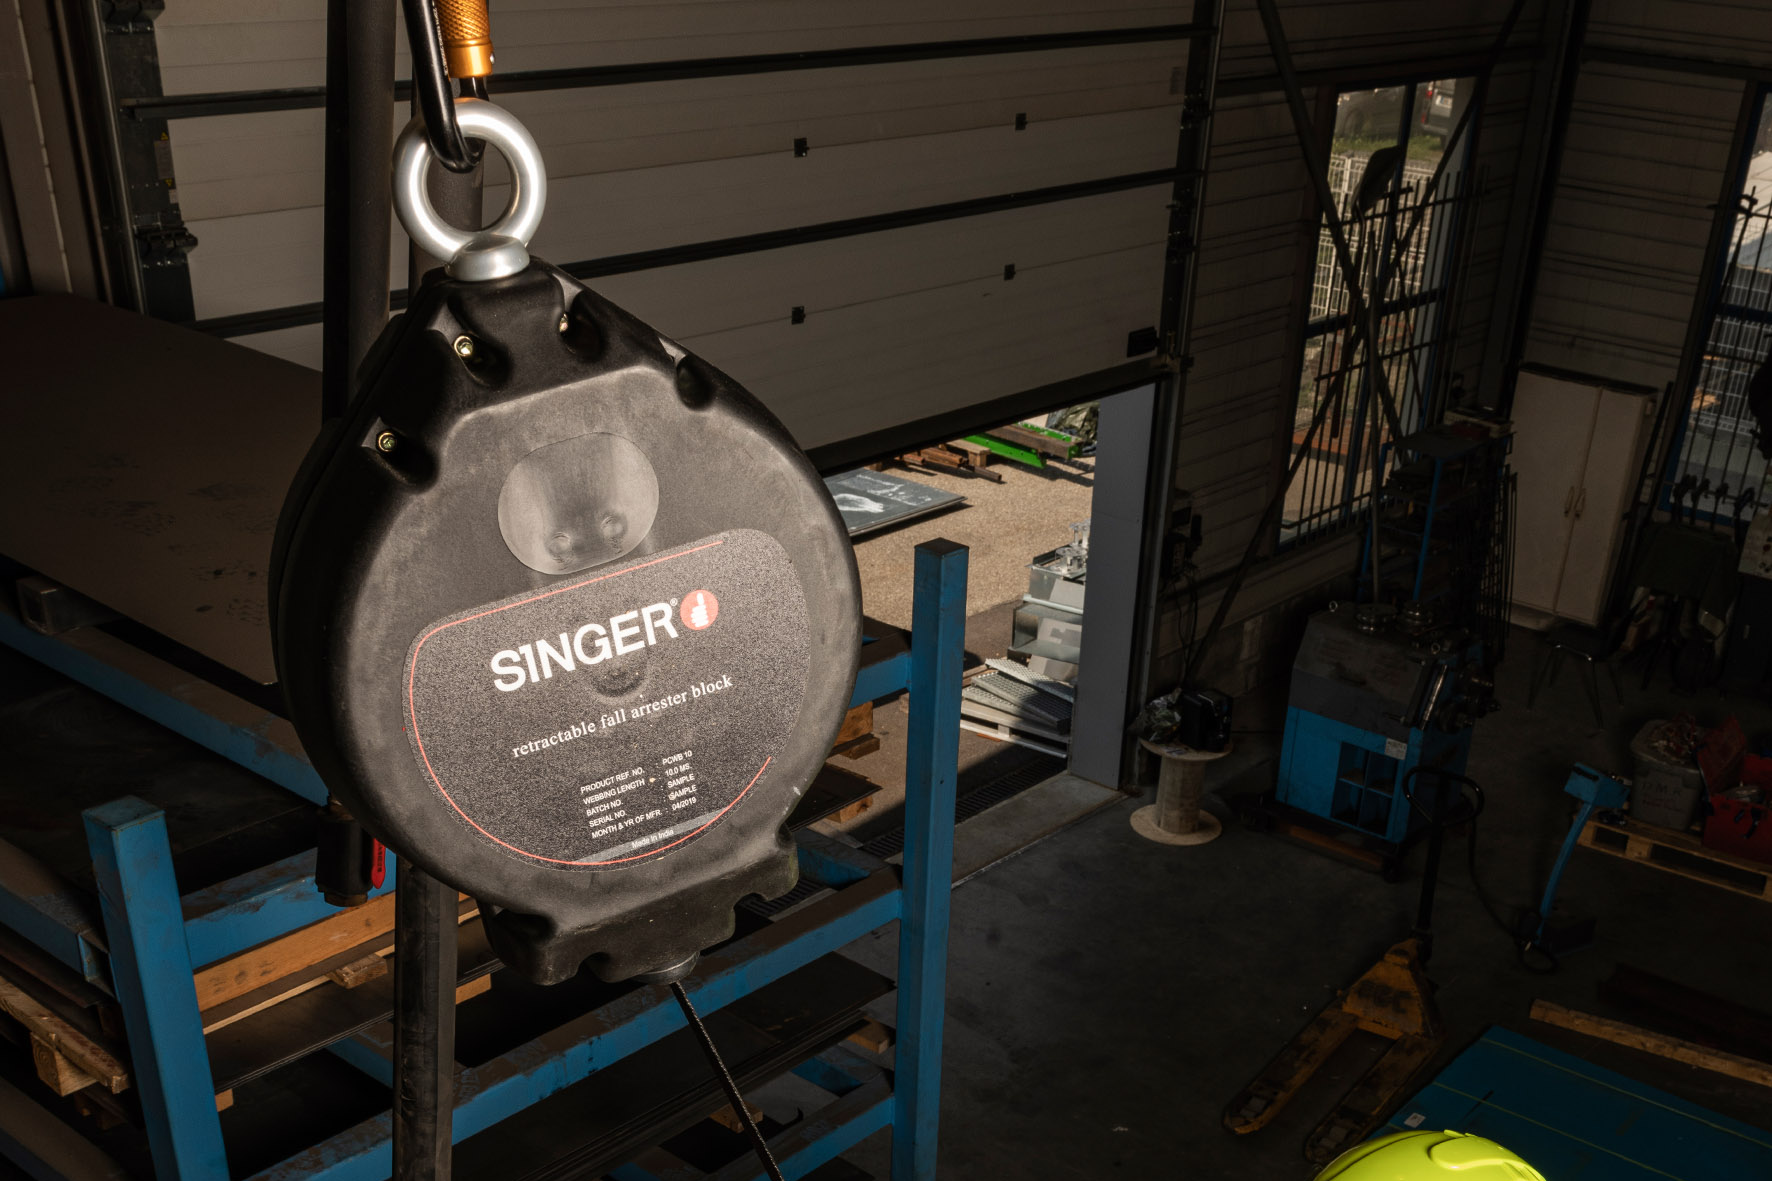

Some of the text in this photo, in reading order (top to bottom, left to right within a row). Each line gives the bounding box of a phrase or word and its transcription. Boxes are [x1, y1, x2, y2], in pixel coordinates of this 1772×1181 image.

[512, 675, 734, 758] retractable fall arrester block
[580, 777, 615, 794] PRODUCT
[662, 753, 683, 765] PCWB
[684, 750, 692, 758] 10
[583, 788, 616, 805] WEBBING
[617, 778, 645, 794] LENGTH
[586, 802, 610, 817] BATCH
[667, 773, 695, 789] SAMPLE
[589, 813, 613, 828] SERIAL
[668, 784, 697, 800] SAMPLE
[592, 823, 617, 839] MONTH
[624, 818, 634, 828] YR
[635, 815, 645, 824] OF
[631, 836, 650, 848] Made
[658, 828, 674, 840] India
